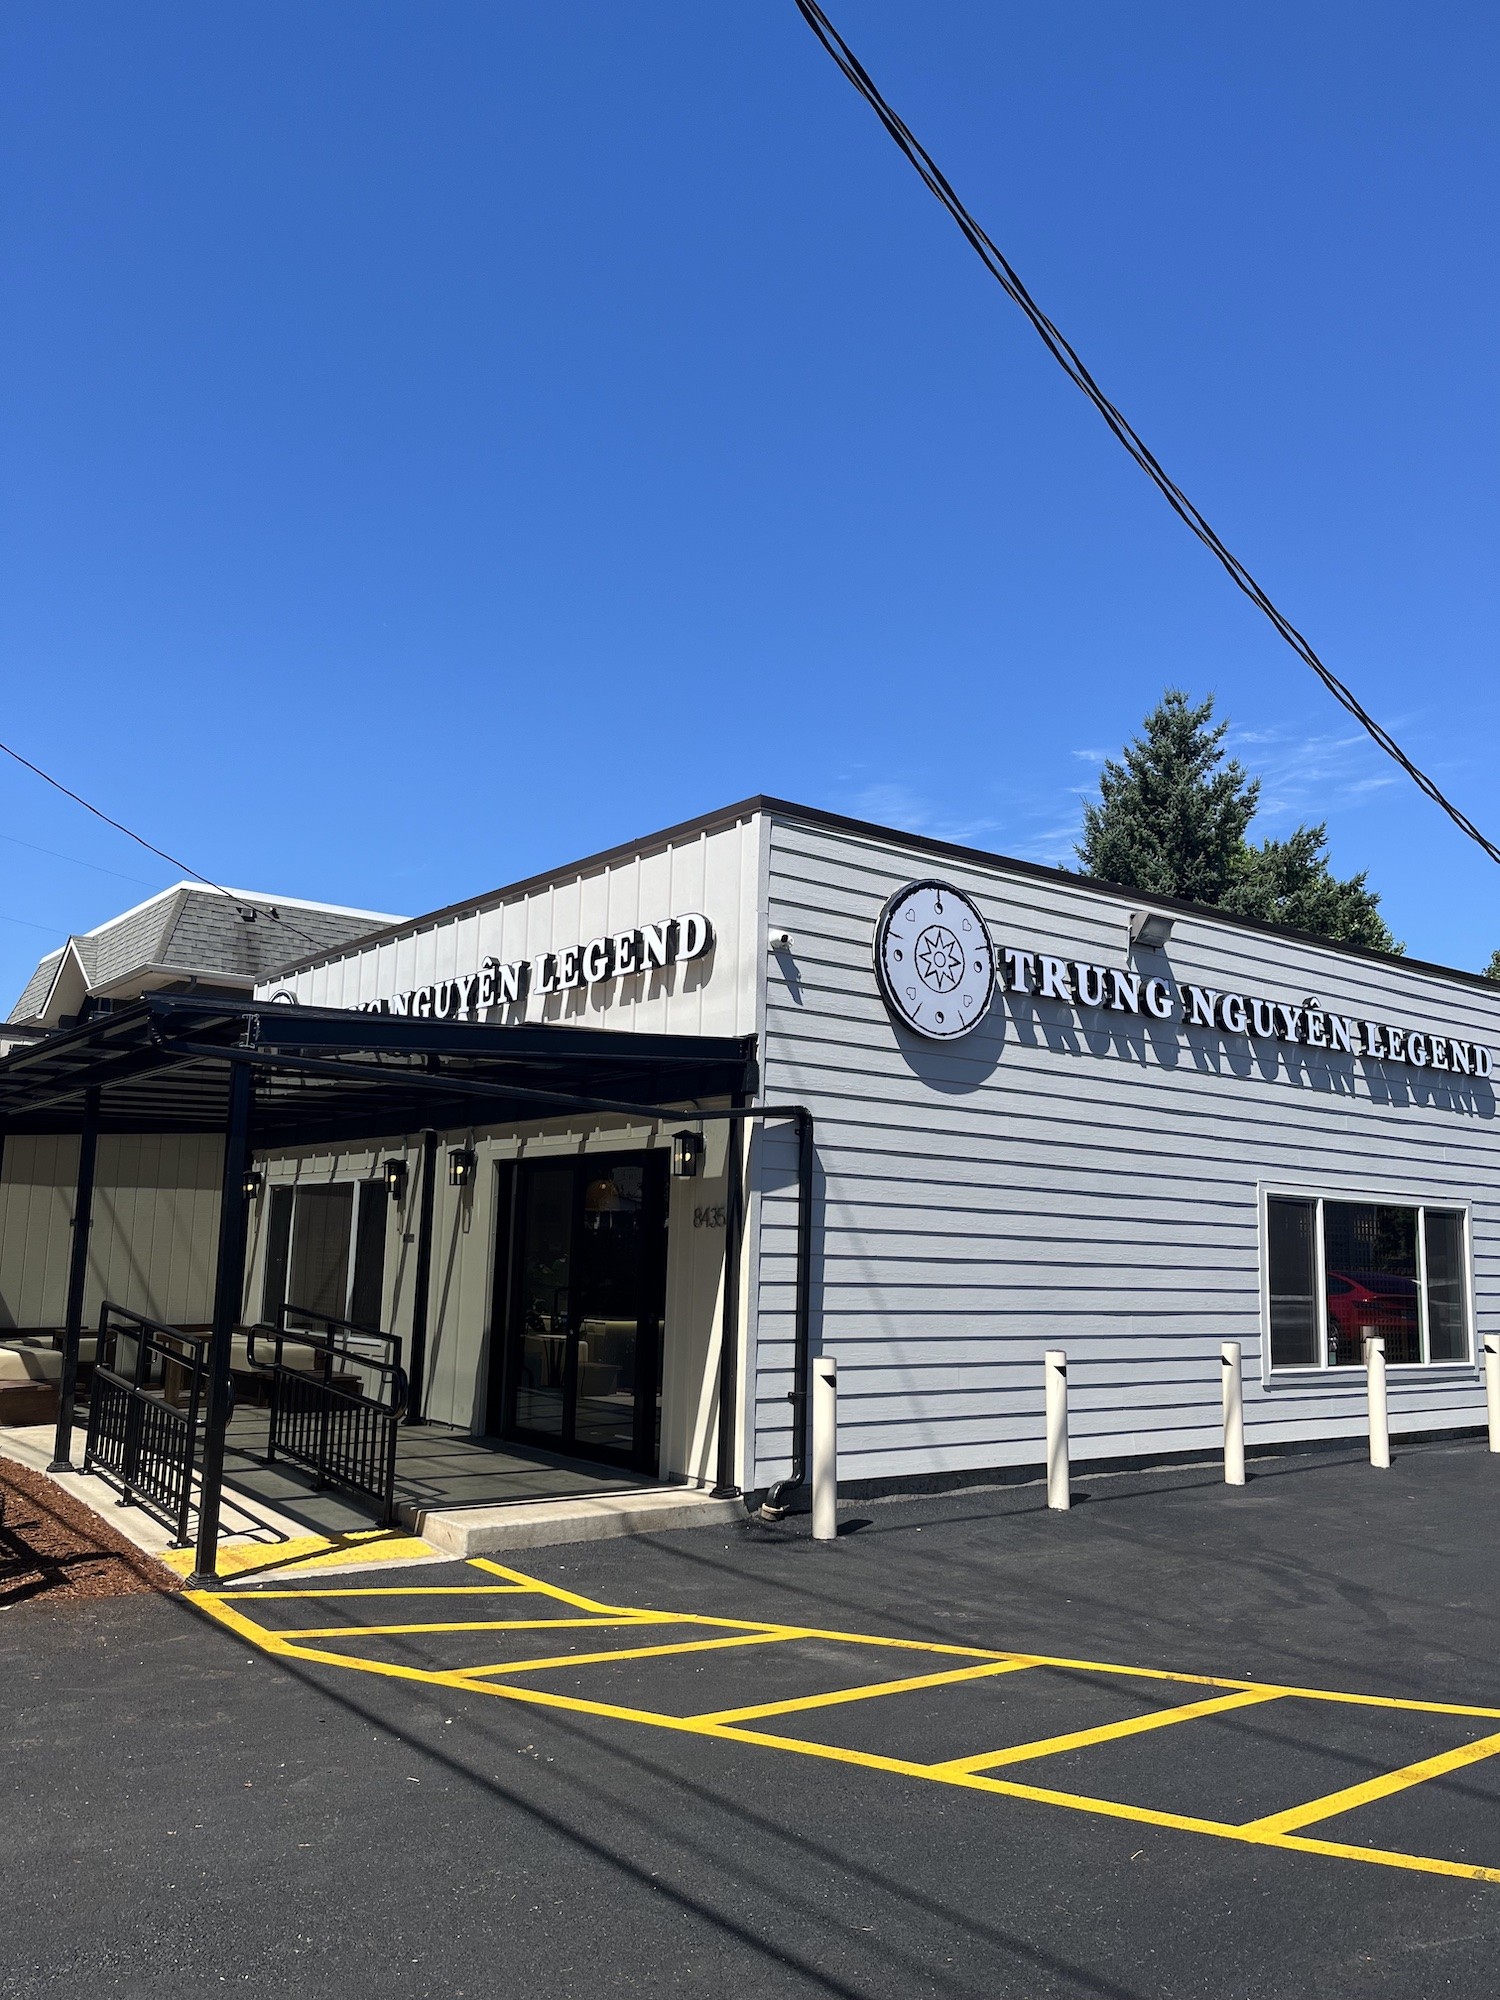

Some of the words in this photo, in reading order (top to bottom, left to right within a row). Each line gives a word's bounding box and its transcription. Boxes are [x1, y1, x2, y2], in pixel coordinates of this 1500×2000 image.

[391, 956, 526, 1019] NGUYÊN
[533, 912, 710, 995] LEGEND
[1001, 948, 1174, 1018] TRUNG
[1186, 985, 1352, 1052] NGUYÊN
[1362, 1021, 1493, 1077] LEGEND
[693, 1207, 726, 1228] 8435
